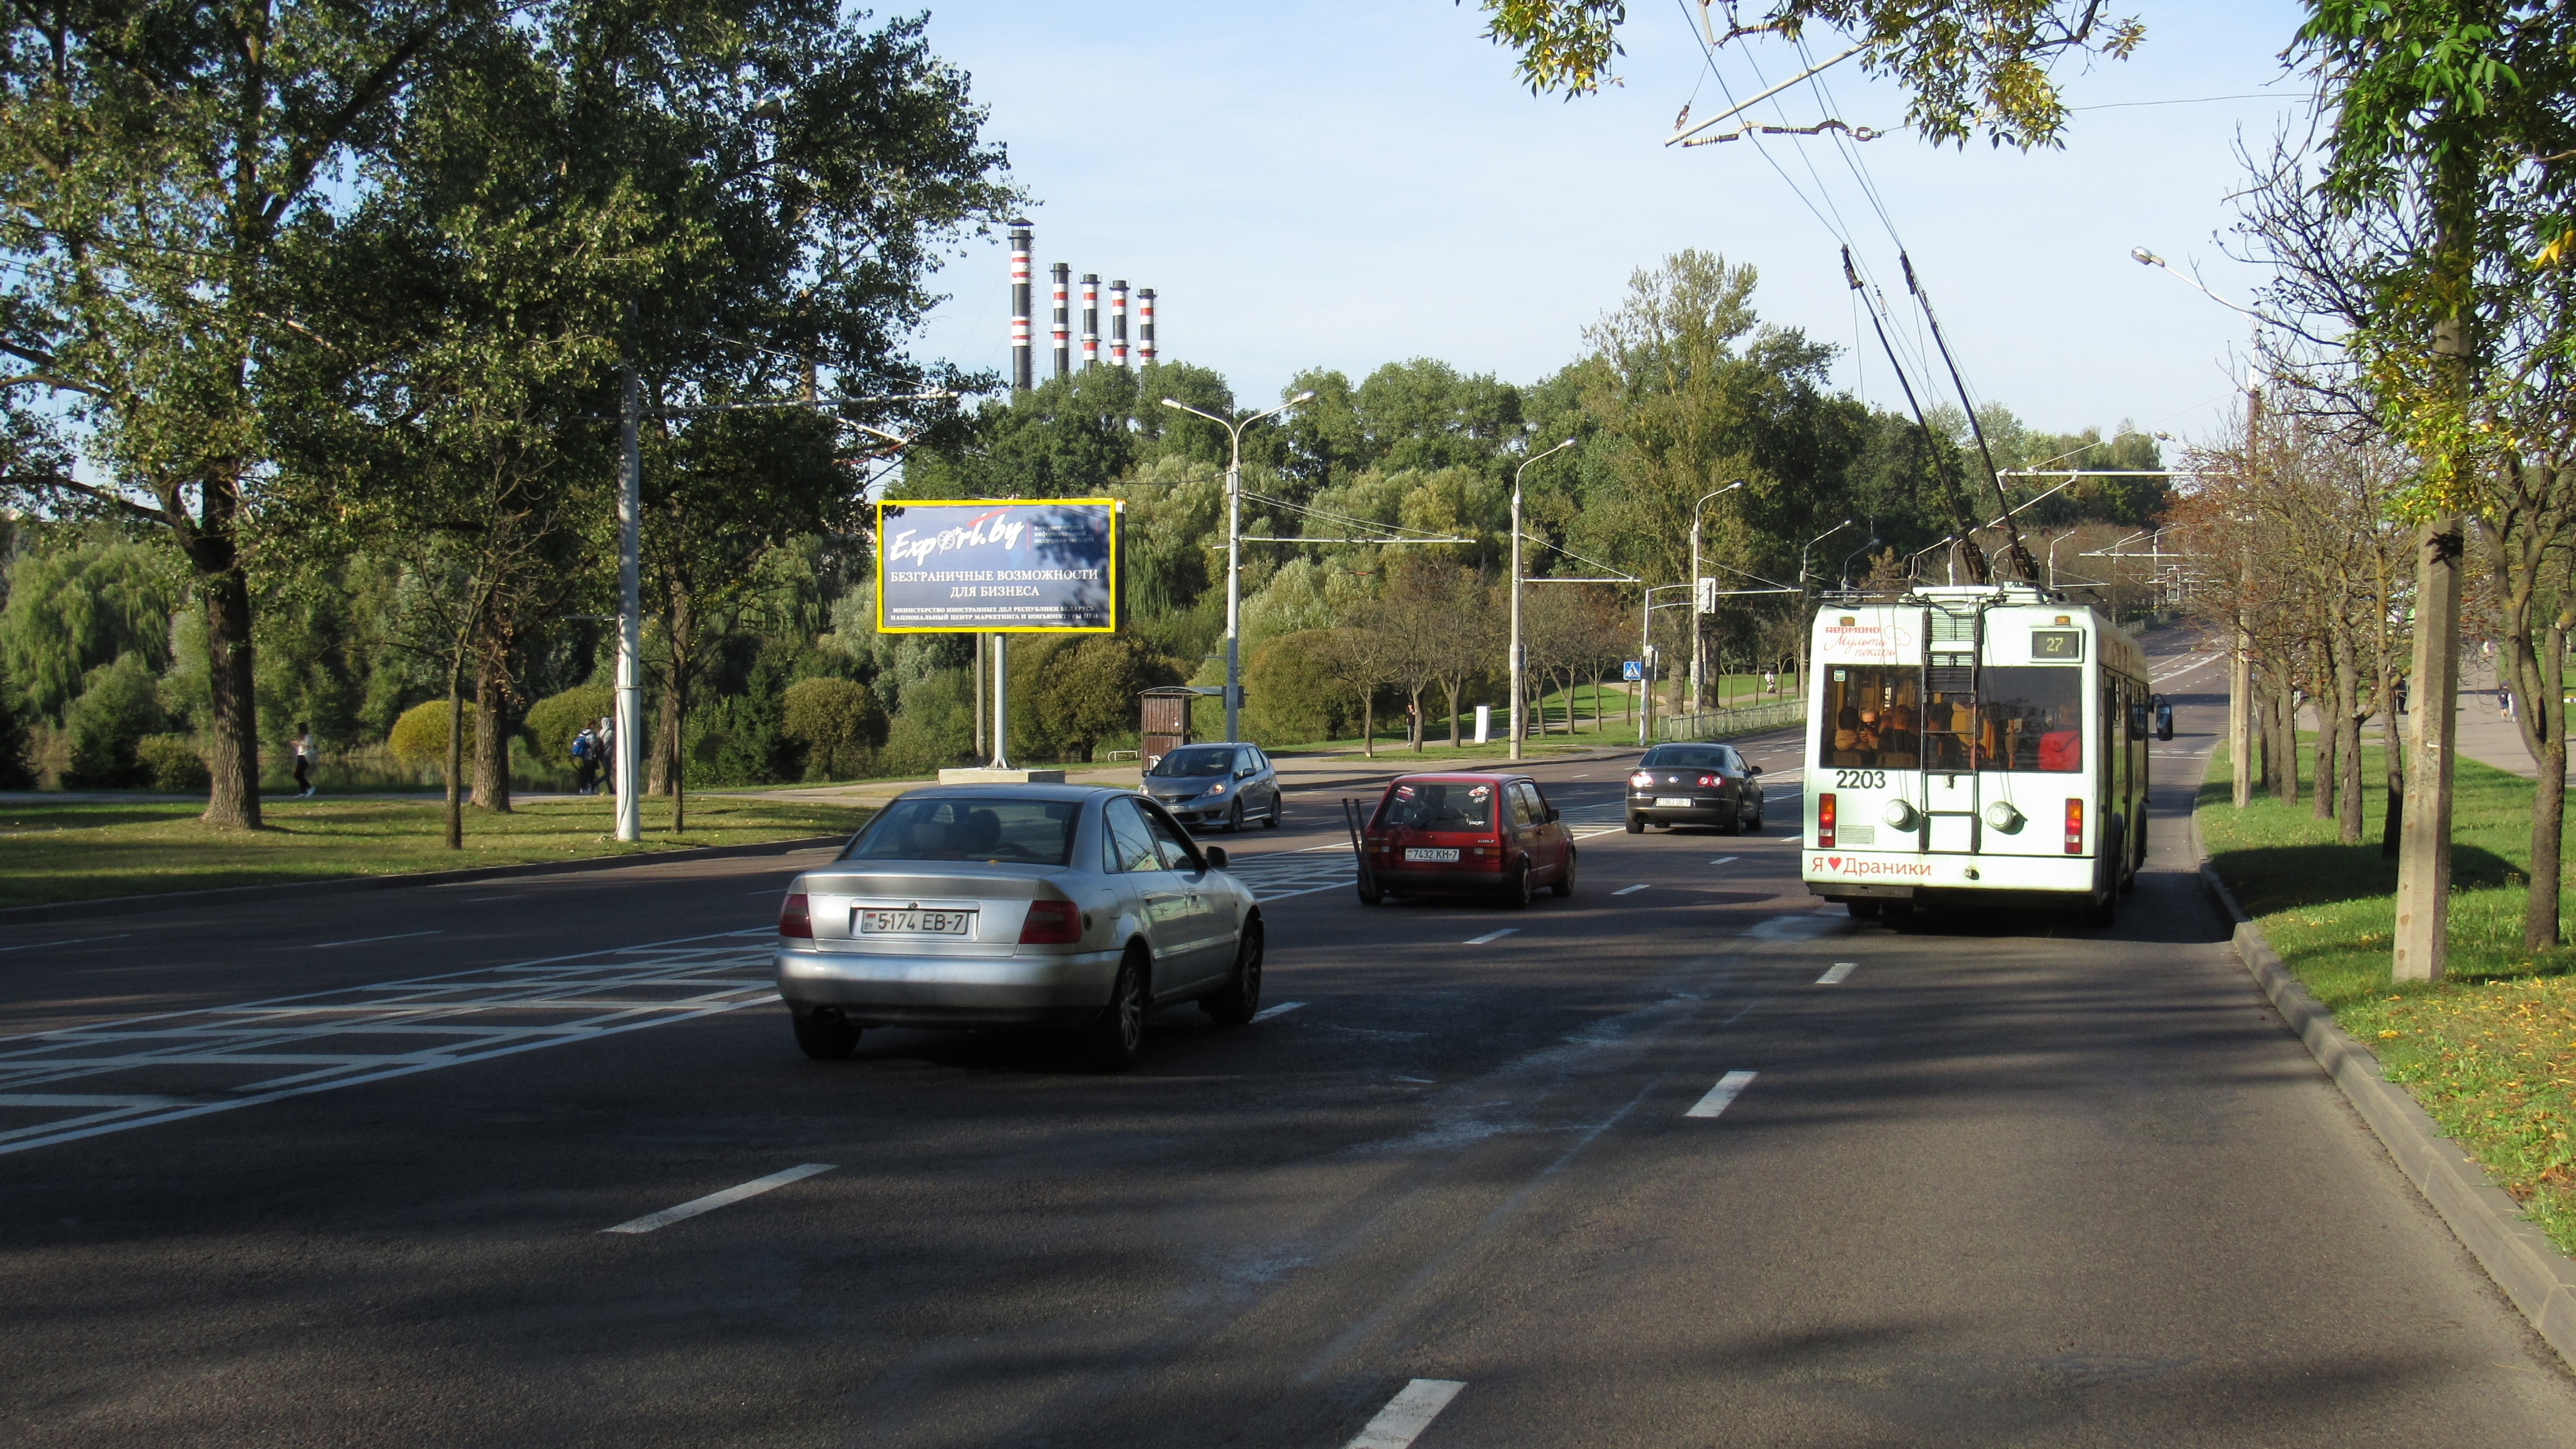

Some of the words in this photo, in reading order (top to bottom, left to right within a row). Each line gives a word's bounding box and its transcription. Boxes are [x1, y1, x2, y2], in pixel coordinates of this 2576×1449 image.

[890, 508, 1025, 567] Export.by
[891, 571, 994, 582] БЕЗГРАНИЧНЫЕ
[997, 569, 1098, 581] ВОЗМОЖНОСТИ
[950, 586, 977, 599] ДЛЯ
[980, 586, 1040, 597] БИЗНЕСА
[1824, 632, 1888, 654] Мульти
[2046, 637, 2064, 652] 27
[1855, 648, 1896, 664] пекарь
[1836, 770, 1886, 789] 2203
[1413, 850, 1434, 859] 7432
[1436, 850, 1458, 860] KH-7
[1812, 857, 1824, 873] Я
[1843, 858, 1932, 877] Драники
[878, 913, 916, 930] 5174
[922, 913, 964, 931] EB-7
